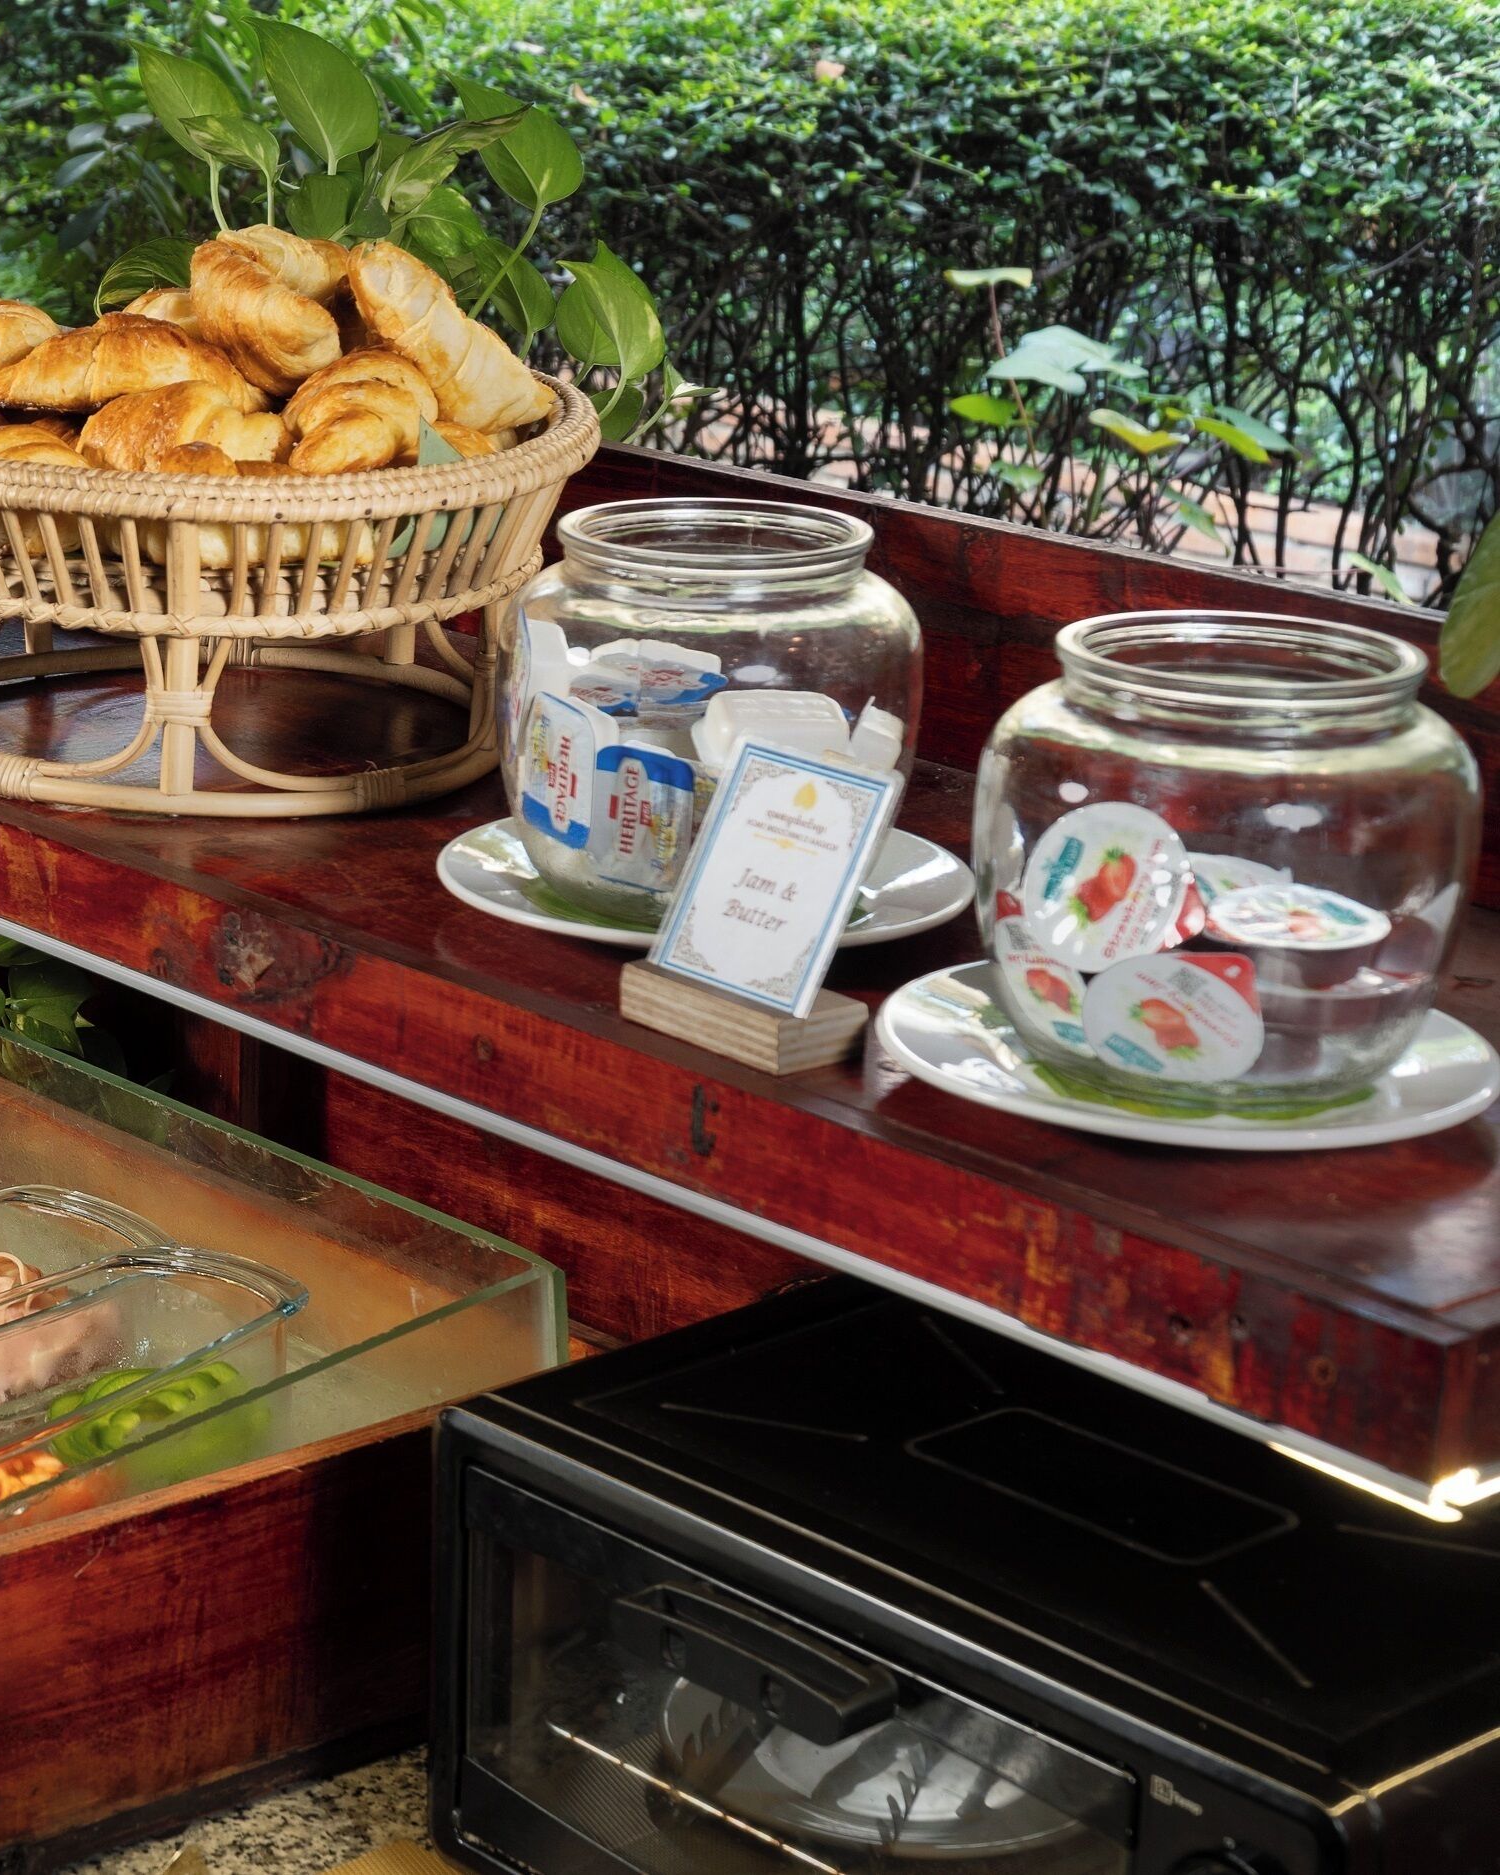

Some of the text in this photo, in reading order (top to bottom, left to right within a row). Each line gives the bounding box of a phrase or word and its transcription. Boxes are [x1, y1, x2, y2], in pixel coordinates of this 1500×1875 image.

[553, 735, 572, 824] HERITAGE
[617, 764, 640, 855] HERITAGE
[723, 898, 787, 932] Butter
[732, 867, 799, 903] Jam &
